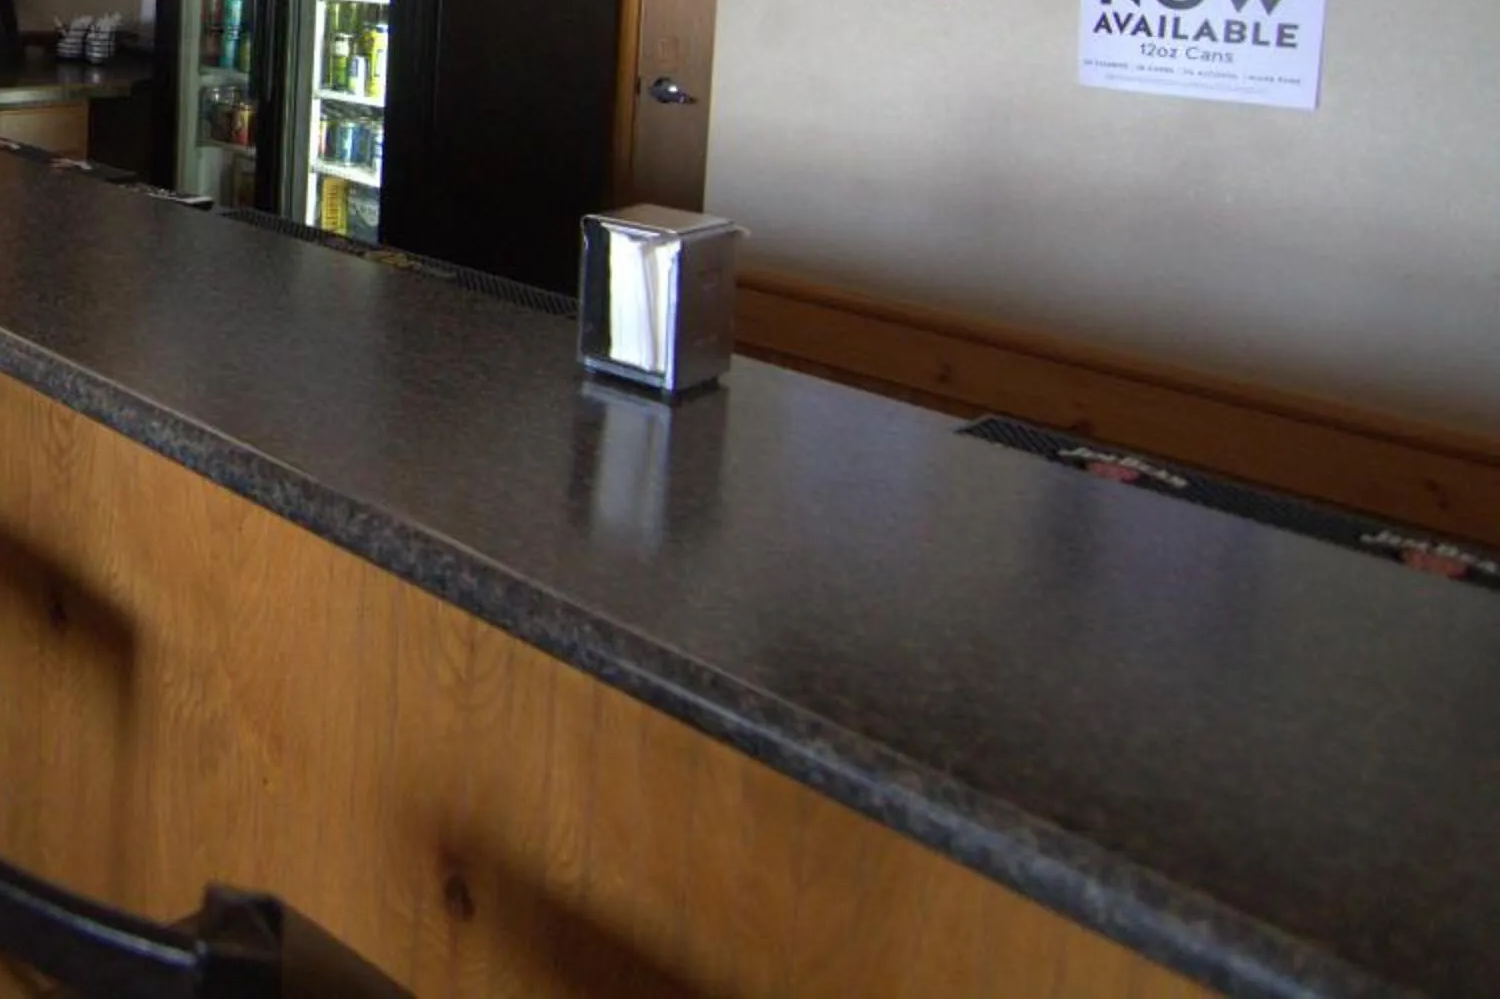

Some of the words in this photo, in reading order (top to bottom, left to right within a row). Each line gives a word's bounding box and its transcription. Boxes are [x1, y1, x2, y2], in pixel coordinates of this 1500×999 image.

[1093, 11, 1299, 49] AVAILABLE
[1140, 43, 1177, 59] 12oz
[1185, 46, 1235, 64] Cans
